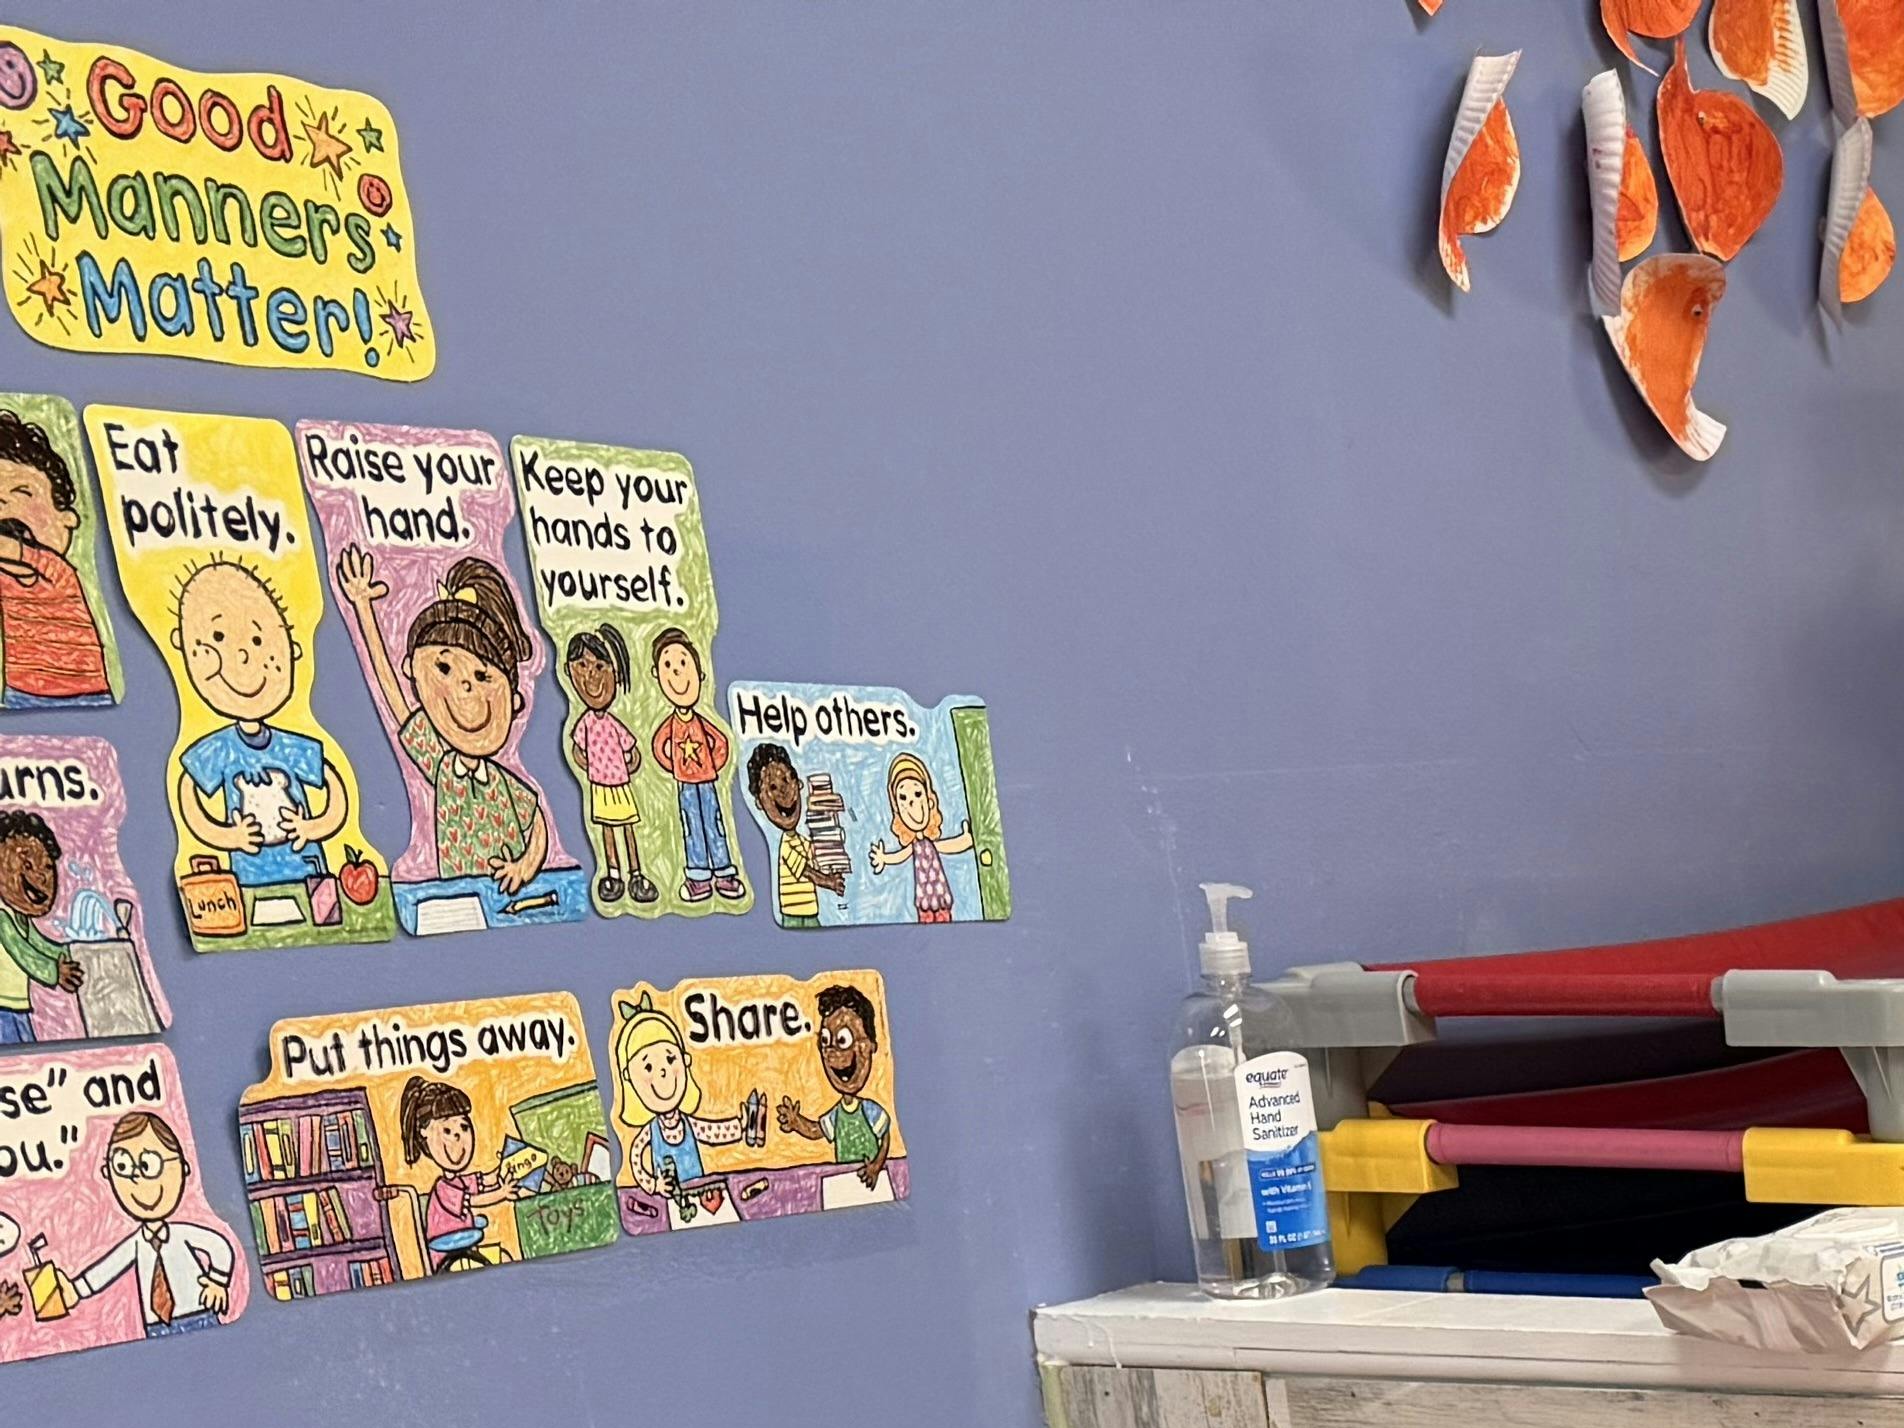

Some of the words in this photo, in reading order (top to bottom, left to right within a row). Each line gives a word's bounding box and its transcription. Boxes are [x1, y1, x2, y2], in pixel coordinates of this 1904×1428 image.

[87, 55, 293, 162] Good
[30, 150, 376, 273] Manners
[76, 251, 380, 367] Matter!
[103, 422, 178, 474] Eat
[306, 434, 406, 483] Raise
[414, 452, 495, 494] your
[520, 450, 604, 506] Keep
[615, 472, 688, 510] your
[121, 487, 295, 553] politely.
[361, 496, 471, 540] hand.
[529, 505, 631, 551] hands
[641, 517, 677, 556] to
[541, 565, 684, 608] yourself.
[737, 692, 807, 747] Help
[815, 696, 916, 738] others.
[189, 893, 238, 919] Lunch
[684, 990, 813, 1046] Share.
[282, 1032, 346, 1078] Put
[358, 1022, 467, 1073] things
[478, 1017, 575, 1058] away.
[83, 1058, 161, 1107] and
[1246, 1068, 1289, 1086] equate
[1249, 1090, 1300, 1109] Advanced
[1250, 1108, 1282, 1124] Hand
[1252, 1125, 1299, 1140] Sanitizer
[527, 1204, 585, 1236] Toys
